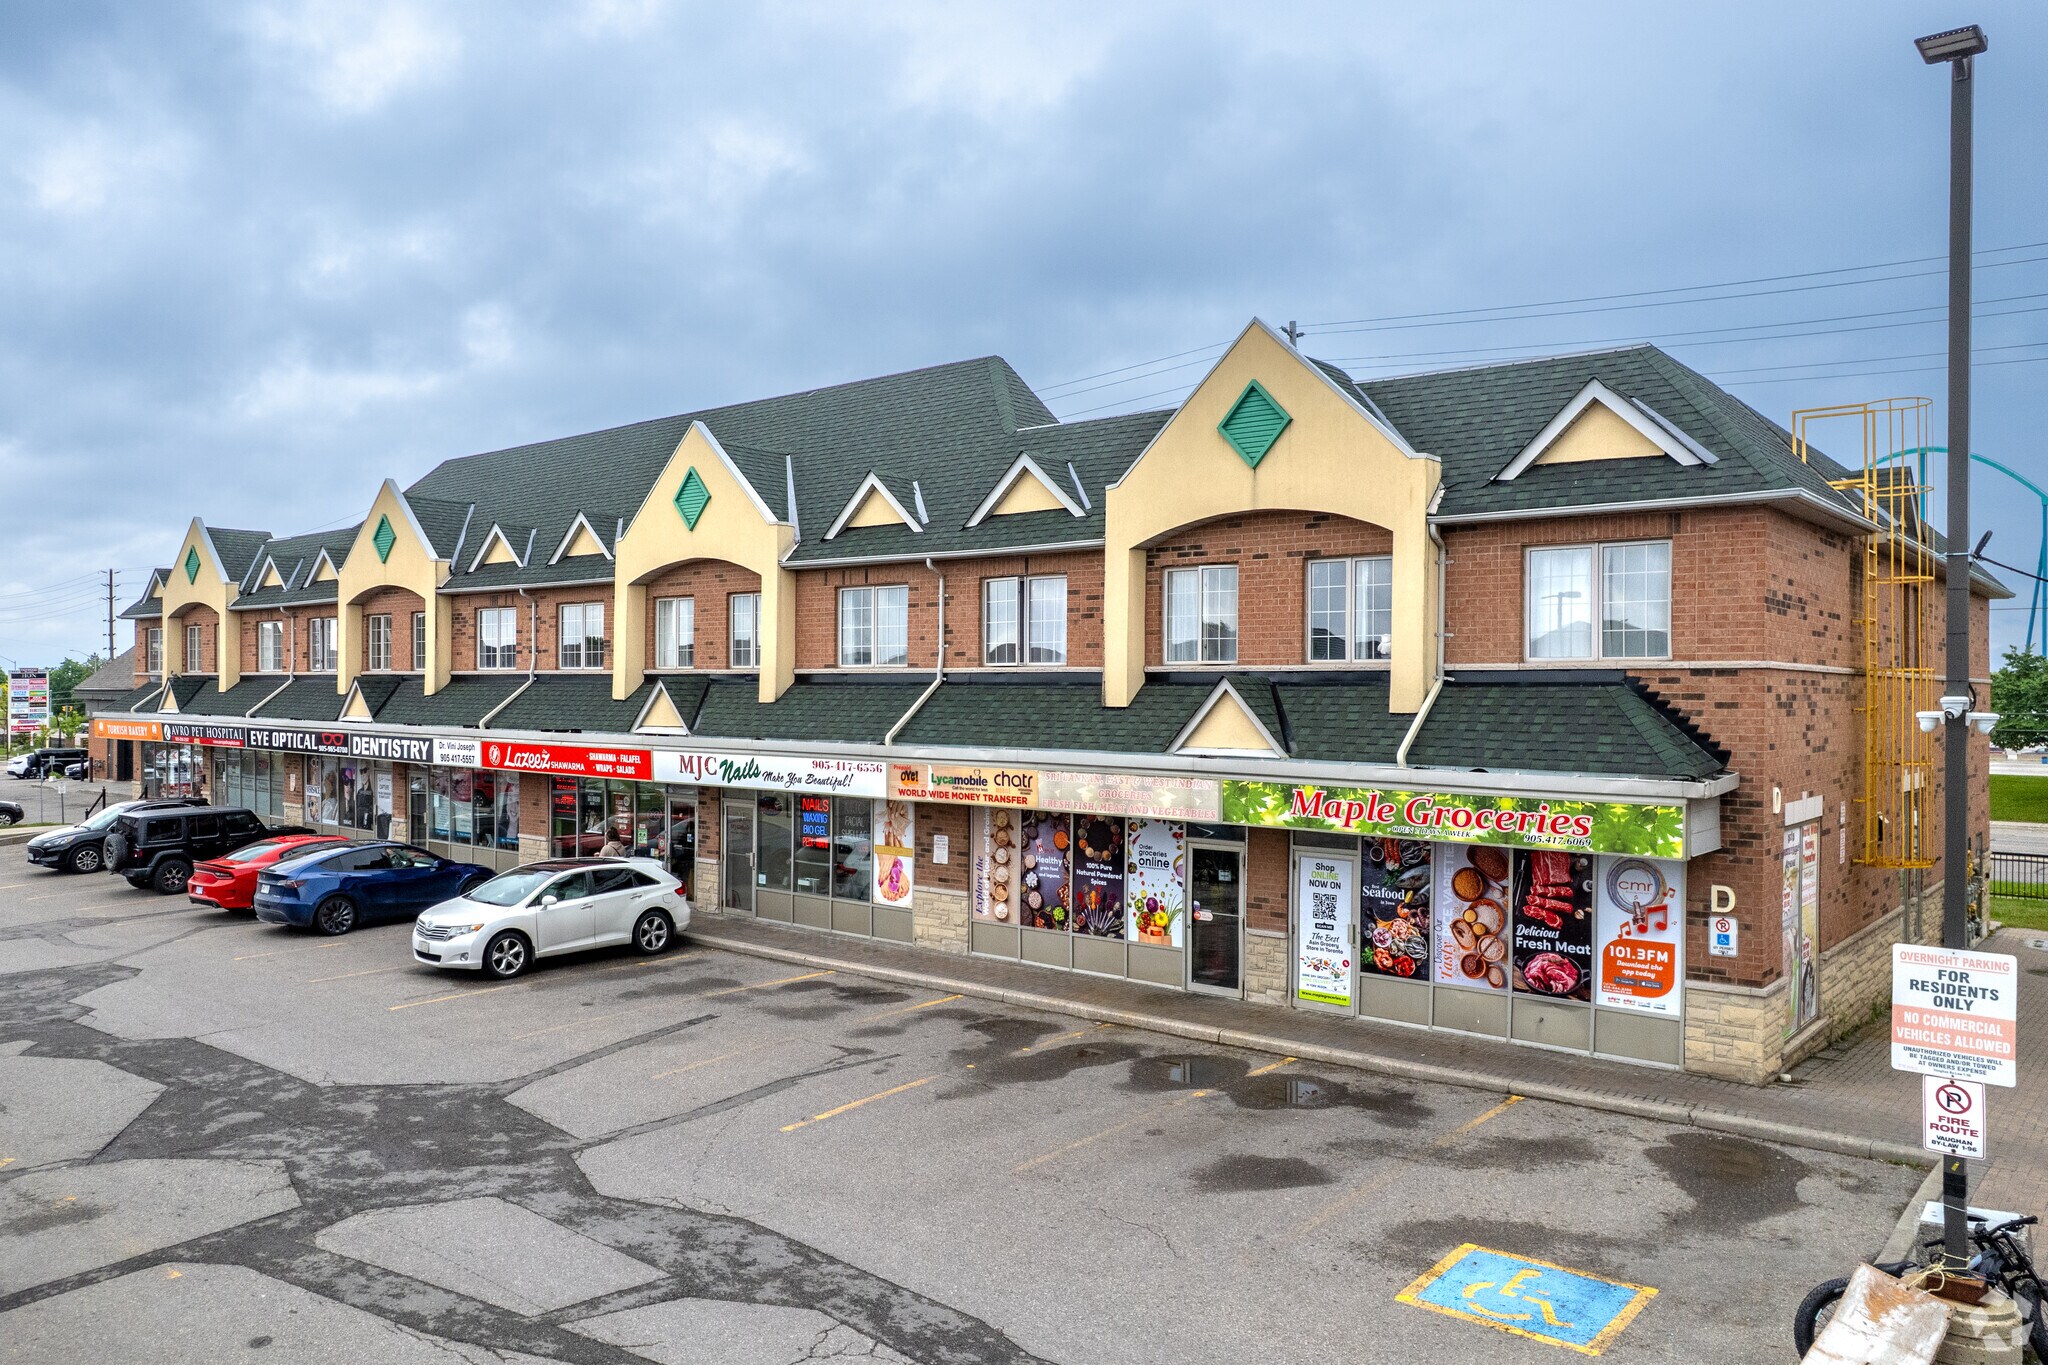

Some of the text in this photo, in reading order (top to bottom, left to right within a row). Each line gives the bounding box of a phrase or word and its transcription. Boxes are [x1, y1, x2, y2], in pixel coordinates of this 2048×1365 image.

[107, 725, 147, 736] TURKISH BAKERY
[172, 726, 243, 740] AVRO PET HOSPITAL
[250, 731, 318, 750] EYE OPTICAL
[457, 743, 475, 751] Joseph
[353, 736, 429, 760] DENTISTRY
[440, 754, 475, 764] 905 417-5557
[589, 753, 641, 763] SHAWARMA FALAFEL
[550, 762, 585, 770] SHAWARMA
[595, 764, 635, 774] WRAPS SALADS
[679, 755, 717, 780] MJC
[719, 758, 762, 784] Nails
[812, 760, 883, 773] 905-417-6556
[762, 771, 853, 791] Make You Beautiful!
[932, 773, 988, 786] Lycamobile
[994, 771, 1033, 788] chatr
[1046, 773, 1060, 781] SRI
[1106, 775, 1131, 785] EAST
[1144, 777, 1169, 787] WEST
[1174, 779, 1212, 789] INDIAN
[898, 788, 1027, 804] WORLD WIDE MONEY TRANSFER
[1099, 789, 1152, 800] GROCERIES
[802, 798, 829, 812] NAILS
[1043, 800, 1217, 819] FRESH FISH, MEAT AND VEGETABLES
[1290, 788, 1396, 828] Maple
[803, 812, 828, 823] WAXING
[845, 816, 864, 827] FACIAL
[1405, 797, 1593, 838] Groceries
[803, 825, 827, 835] BIO GEL
[1392, 825, 1414, 834] OPEN
[1524, 834, 1592, 847] 905.417.6069
[1036, 856, 1062, 867] Healthy
[1139, 857, 1169, 868] online
[1315, 863, 1335, 873] Shop
[1076, 869, 1096, 877] Natural
[1311, 871, 1339, 880] ONLINE
[983, 880, 989, 889] of
[1090, 878, 1107, 886] Spices
[1309, 879, 1328, 889] NOW
[1618, 881, 1653, 891] cmr
[976, 874, 984, 913] Explore
[1362, 886, 1404, 900] Seafood
[1711, 884, 1735, 913] D
[1443, 908, 1453, 937] RICE
[1312, 932, 1340, 942] The Best
[1516, 924, 1559, 938] Delicious
[1320, 941, 1339, 949] Grocery
[1326, 946, 1343, 954] Toronto
[1516, 937, 1591, 955] Fresh Meat
[1439, 942, 1455, 979] Tasty
[1610, 946, 1668, 963] 101.3FM
[1617, 960, 1649, 969] Download
[1900, 951, 2010, 972] OVERNIGHT PARKING
[1636, 970, 1655, 979] today
[1938, 969, 1970, 984] FOR
[1910, 979, 1999, 1001] RESIDENTS
[1934, 996, 1974, 1011] ONLY
[1904, 1011, 2003, 1036] NO COMMERCIAL
[1896, 1027, 2011, 1054] VEHICLES ALLOWED
[1903, 1046, 1951, 1058] UNAUTHORIZED
[1954, 1054, 1986, 1063] VEHICLES
[1920, 1054, 1944, 1063] TAGGED
[1946, 1058, 1970, 1066] AND/OR
[1973, 1063, 1996, 1071] TOWED
[1928, 1062, 1955, 1070] OWNERS
[1957, 1066, 1987, 1075] EXPENSE
[1938, 1116, 1970, 1127] FIRE
[1930, 1123, 1979, 1138] ROUTE
[1931, 1140, 1958, 1148] BY-LAW
[1936, 1135, 1972, 1145] VAUGHAN
